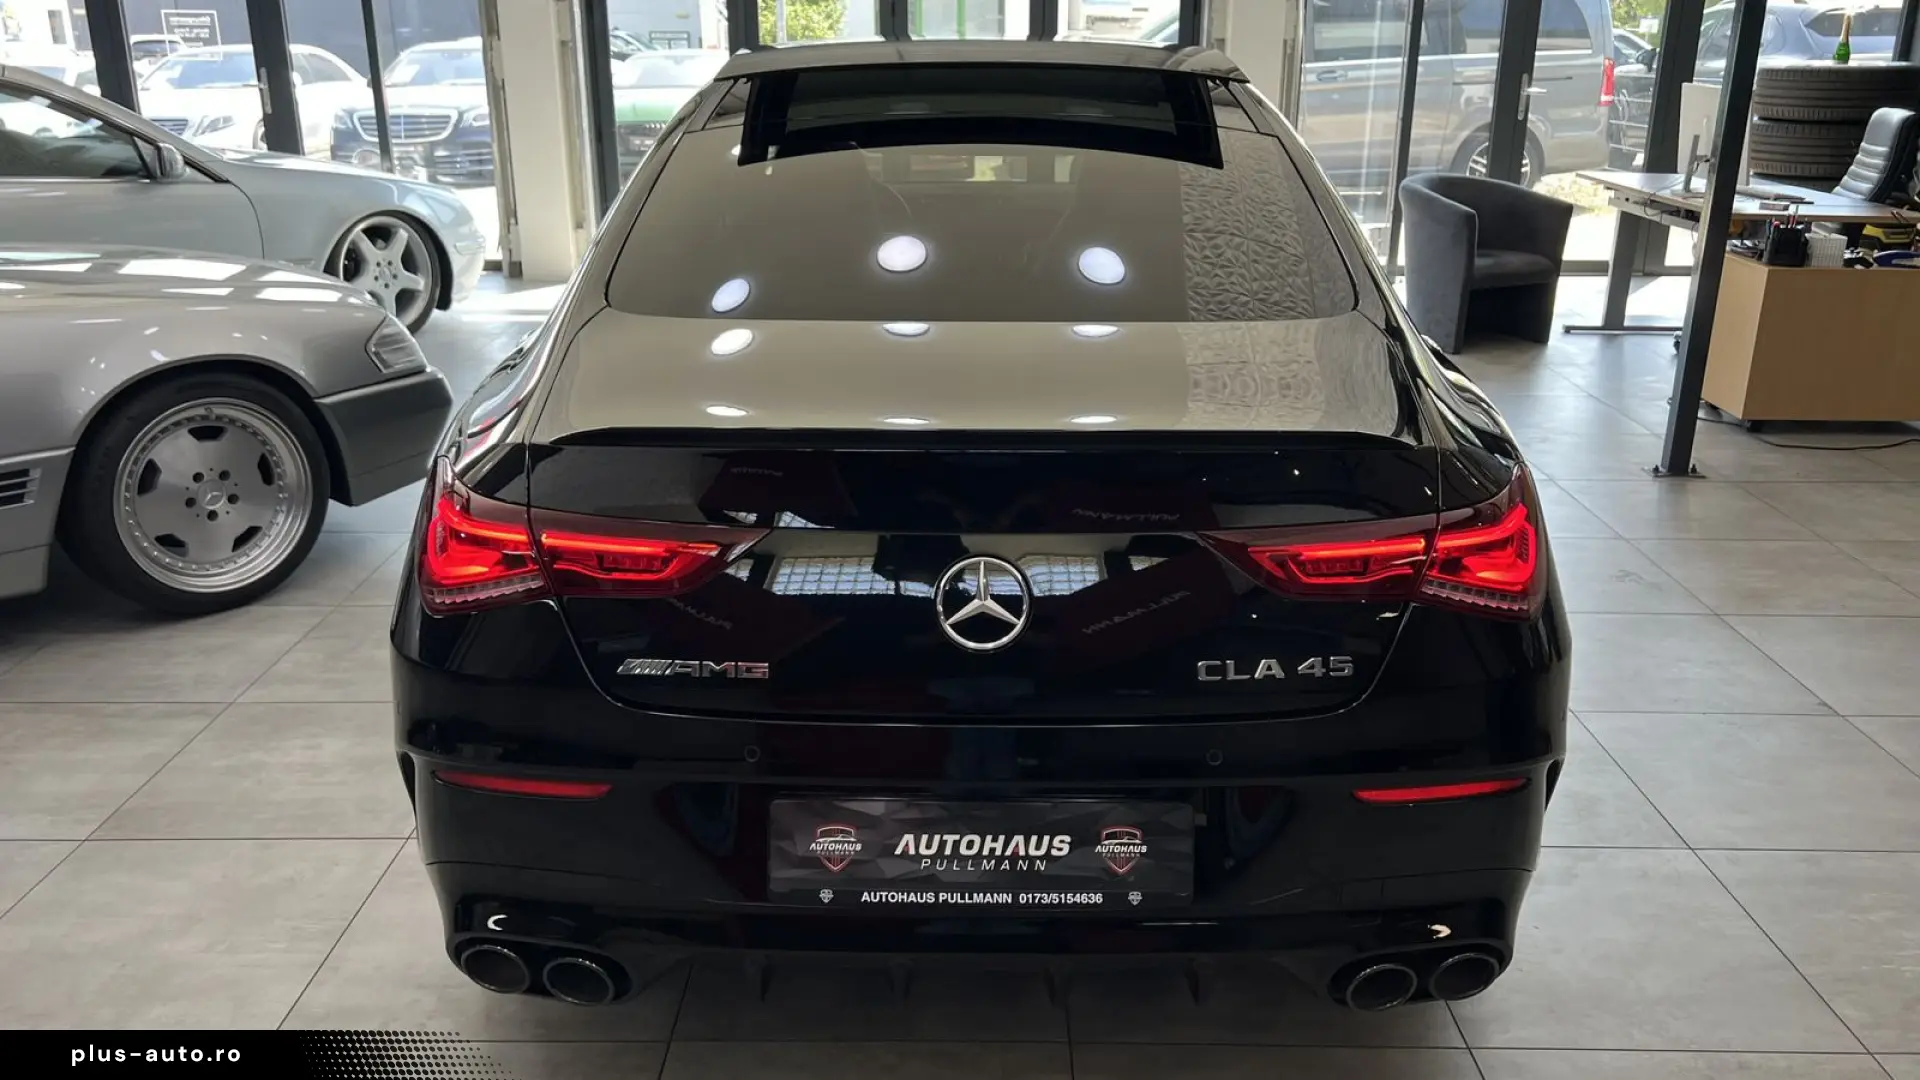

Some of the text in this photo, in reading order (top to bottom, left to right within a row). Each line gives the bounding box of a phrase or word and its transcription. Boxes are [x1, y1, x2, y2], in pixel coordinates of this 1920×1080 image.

[664, 659, 769, 679] AMG
[1197, 655, 1354, 681] CLA 45
[809, 842, 863, 852] AUTOHAUS
[894, 833, 1071, 857] AUTOHAUS
[1094, 844, 1148, 854] AUTOHAUS
[920, 858, 1047, 872] PULLMANN
[860, 891, 1104, 905] AUTOHAUS PULLMANN 0173/5154636
